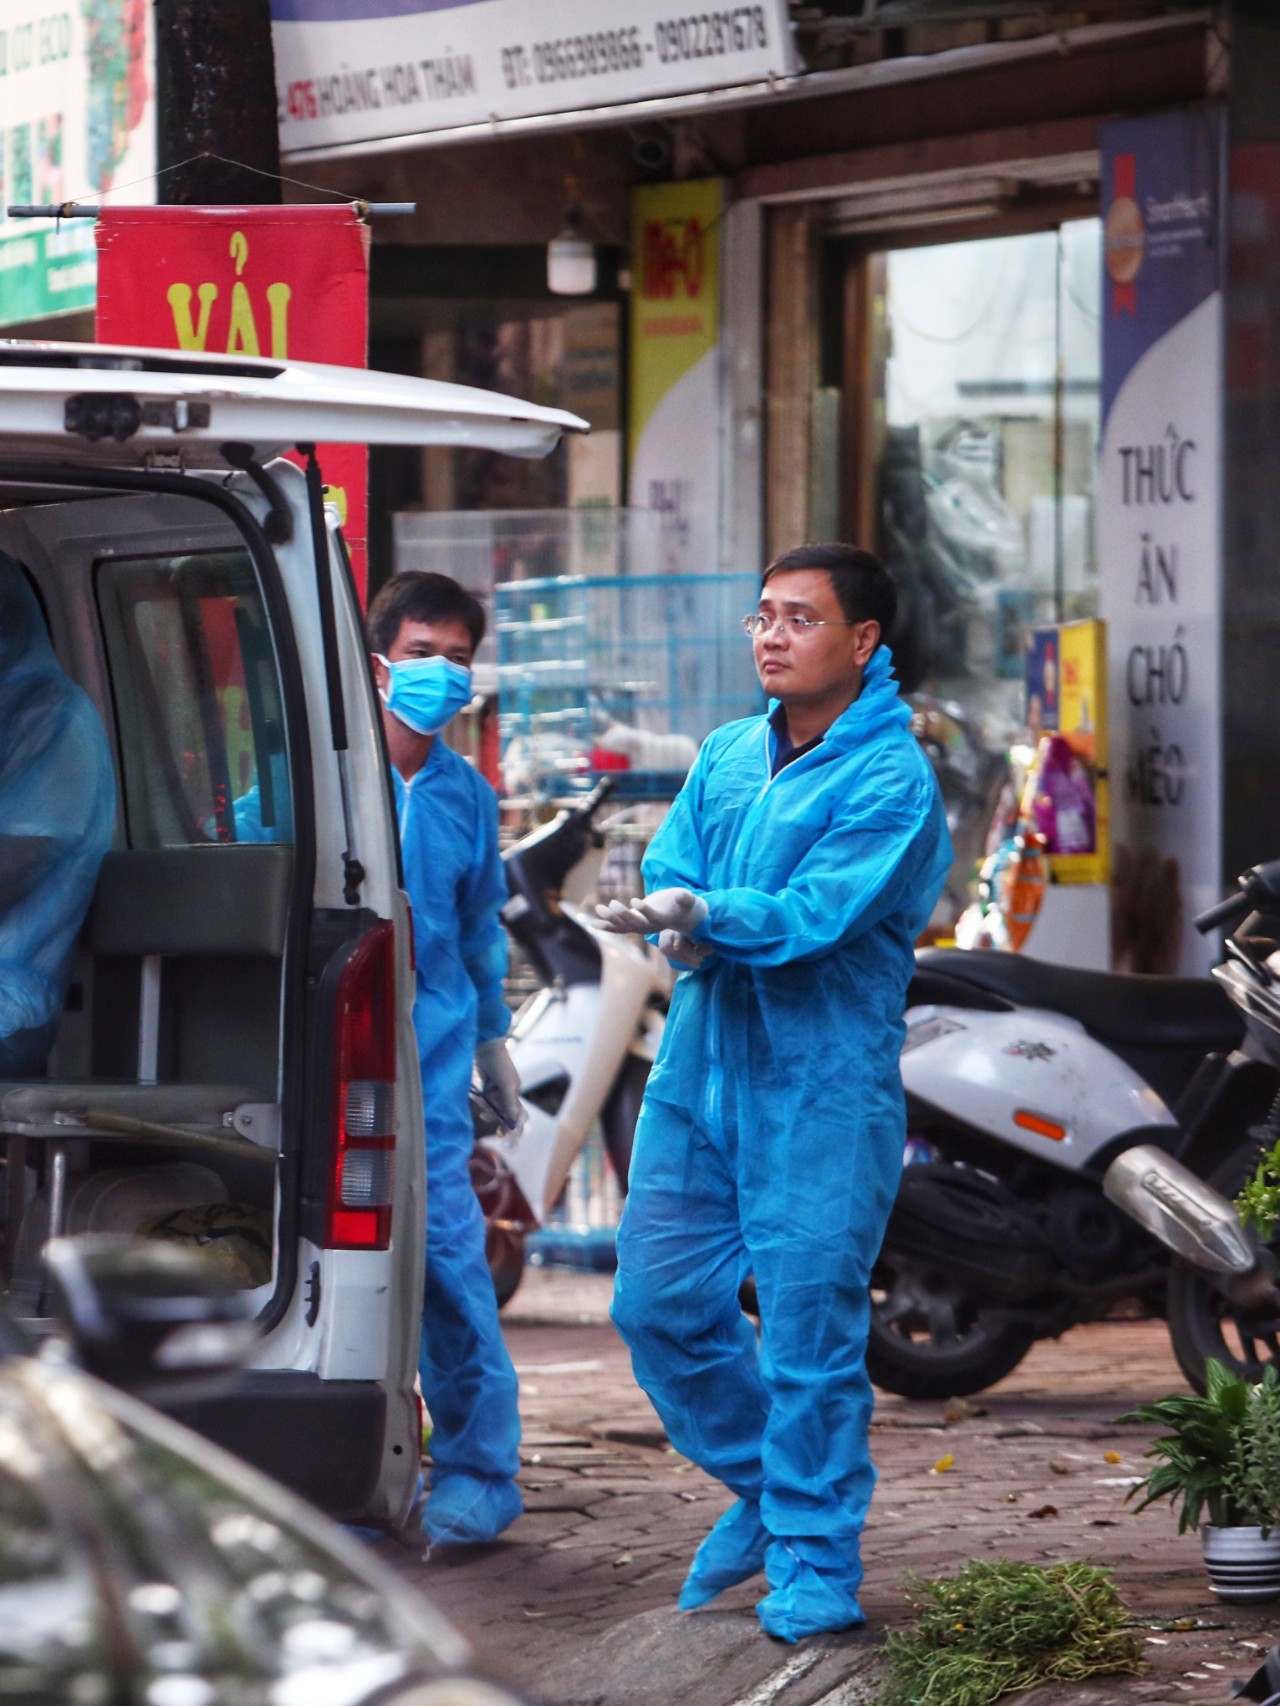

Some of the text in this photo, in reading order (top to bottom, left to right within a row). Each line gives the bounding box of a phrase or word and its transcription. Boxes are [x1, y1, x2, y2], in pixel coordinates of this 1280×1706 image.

[380, 62, 419, 108] HOA
[1118, 421, 1196, 505] THỨC
[1135, 531, 1178, 605] ĂN
[1126, 623, 1188, 707] CHÓ
